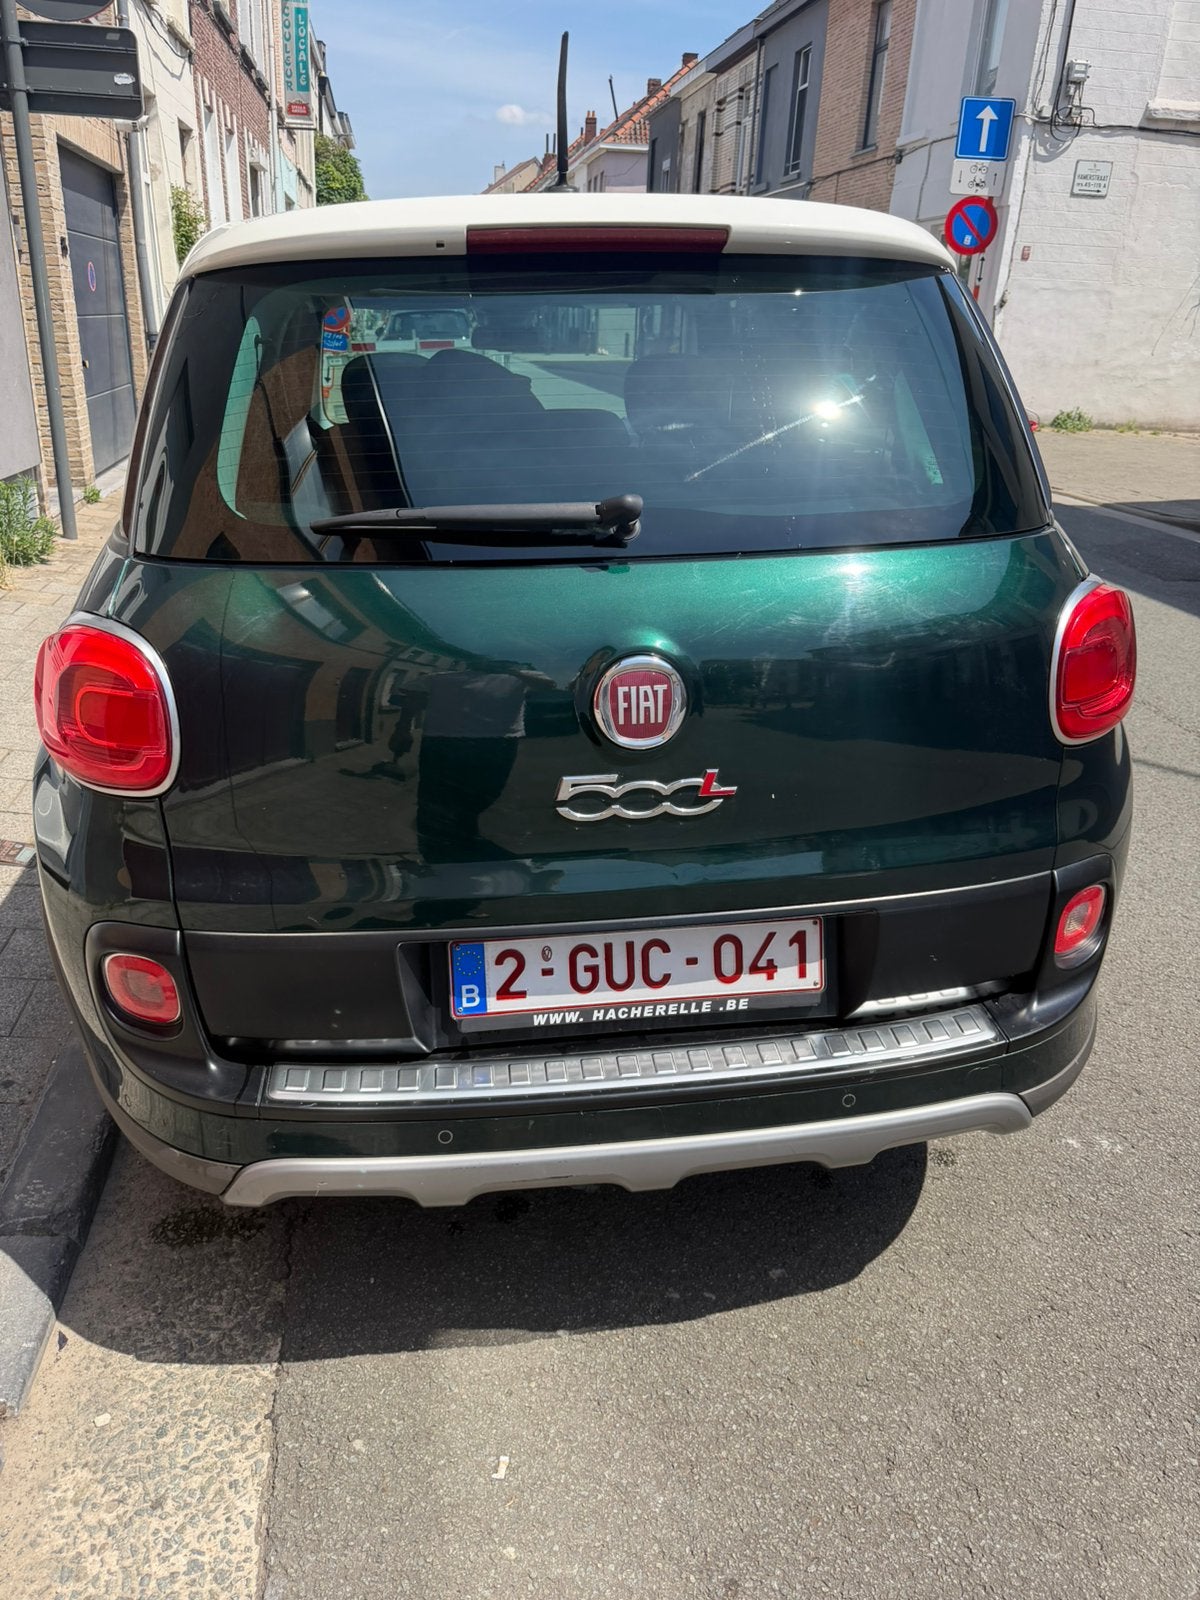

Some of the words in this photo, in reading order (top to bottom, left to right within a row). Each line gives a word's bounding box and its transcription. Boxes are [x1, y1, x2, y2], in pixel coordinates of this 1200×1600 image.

[283, 5, 293, 91] COULEUR
[298, 13, 307, 86] LOCALE
[617, 684, 668, 725] FIAT
[555, 768, 738, 822] 500L
[494, 929, 807, 1001] 2-GUC-041
[461, 984, 480, 1008] B
[533, 1012, 584, 1026] WWW.
[592, 1001, 712, 1021] HACHERELLE
[719, 998, 749, 1011] .BE
